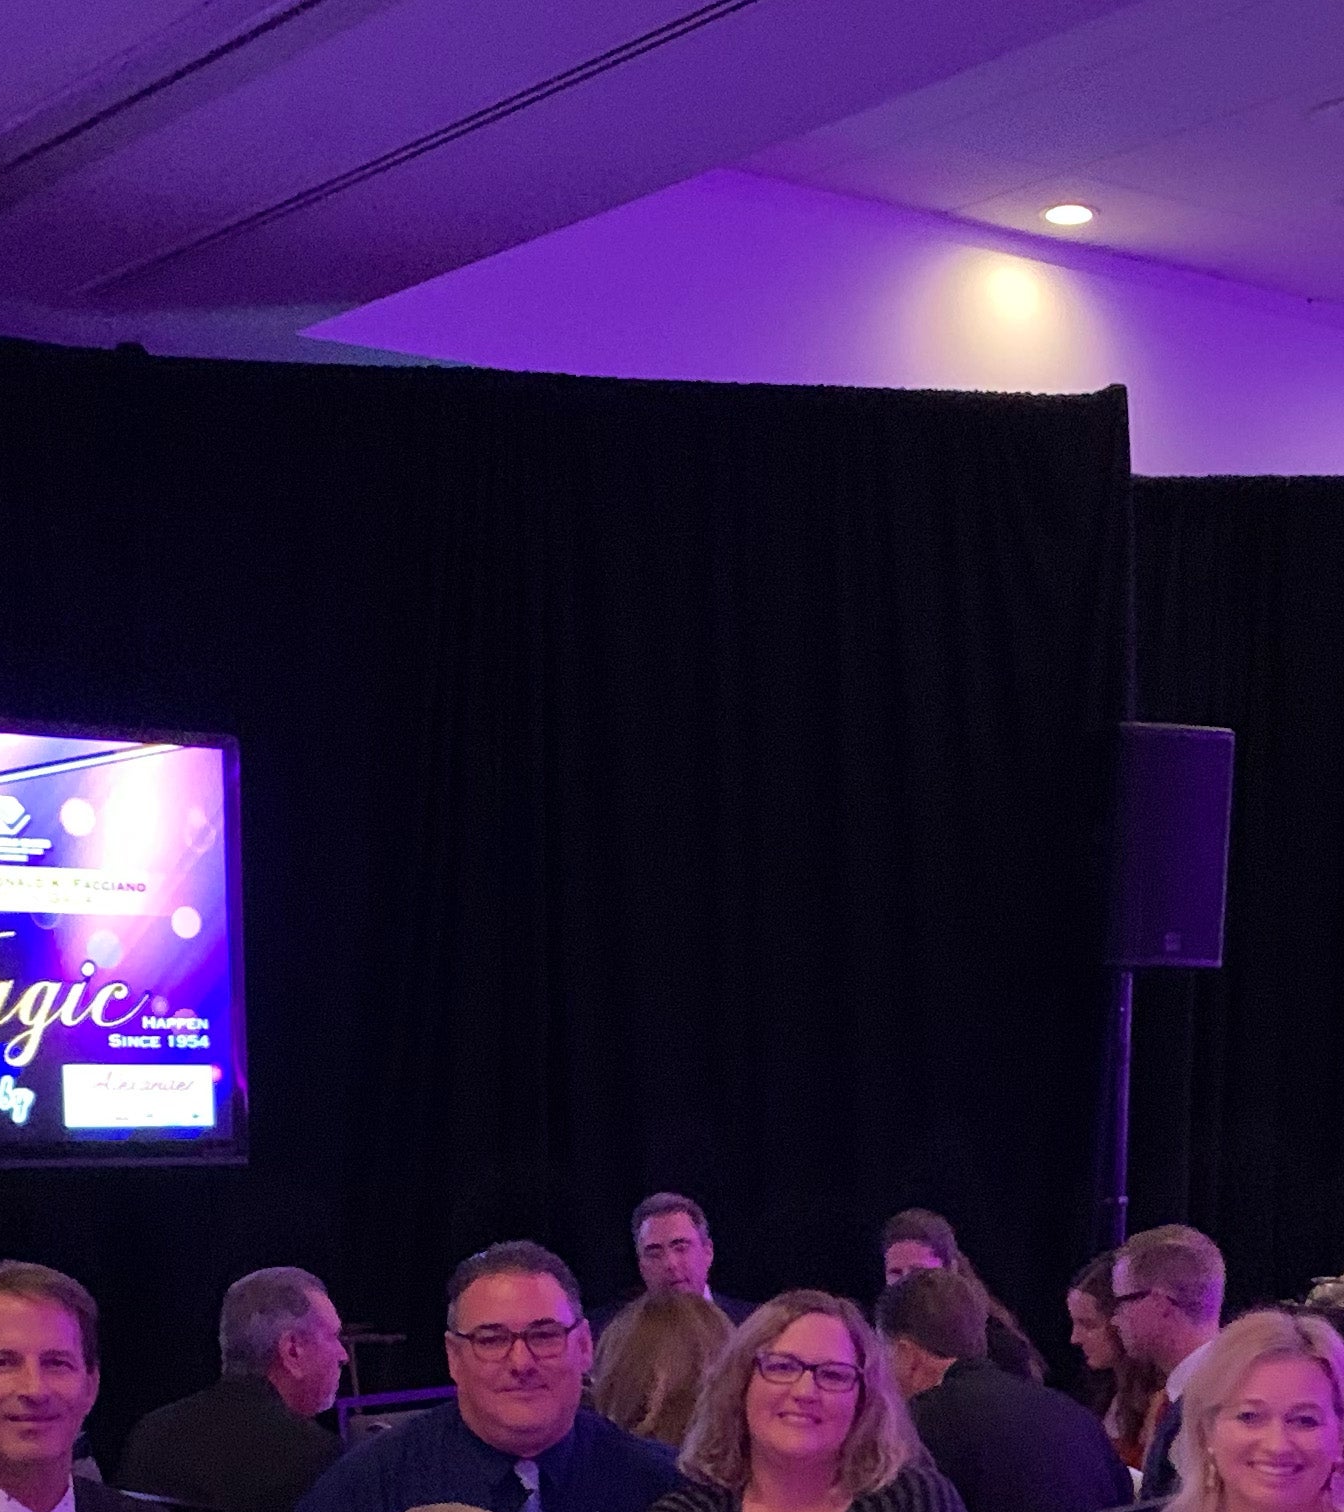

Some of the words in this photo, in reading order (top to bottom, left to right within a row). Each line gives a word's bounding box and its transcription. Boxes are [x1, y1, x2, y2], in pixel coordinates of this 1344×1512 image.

[142, 1016, 209, 1031] HAPPEN
[108, 1033, 162, 1049] SINCE
[167, 1034, 210, 1049] 1954
